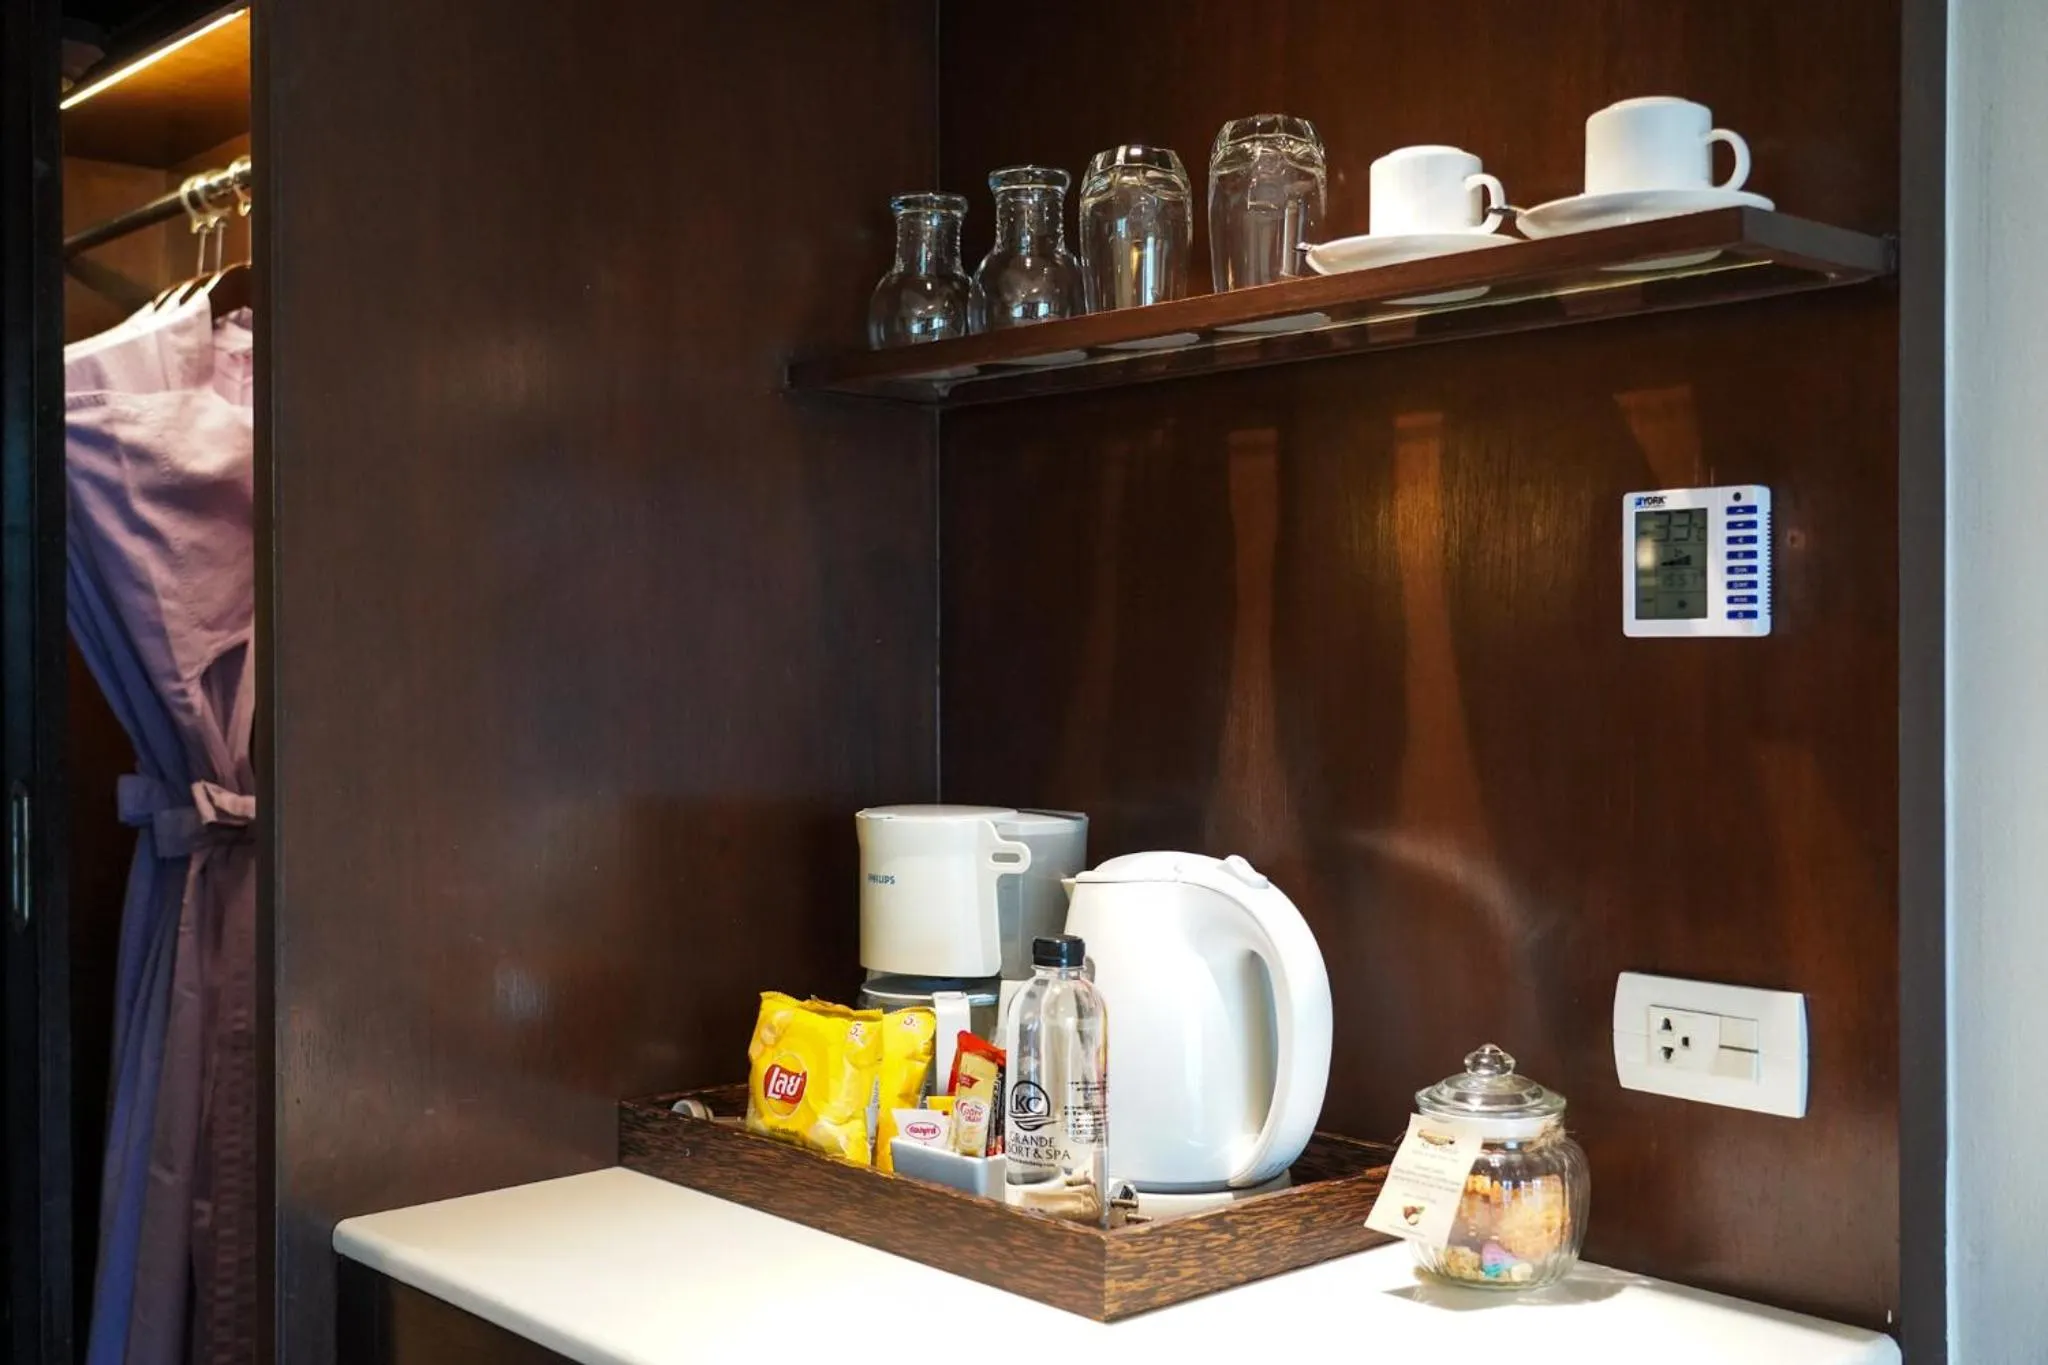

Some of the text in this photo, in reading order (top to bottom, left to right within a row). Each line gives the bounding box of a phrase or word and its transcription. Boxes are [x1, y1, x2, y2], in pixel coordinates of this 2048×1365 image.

[1643, 496, 1665, 505] YORK
[1015, 1094, 1042, 1113] KC
[1045, 1148, 1072, 1160] SPA
